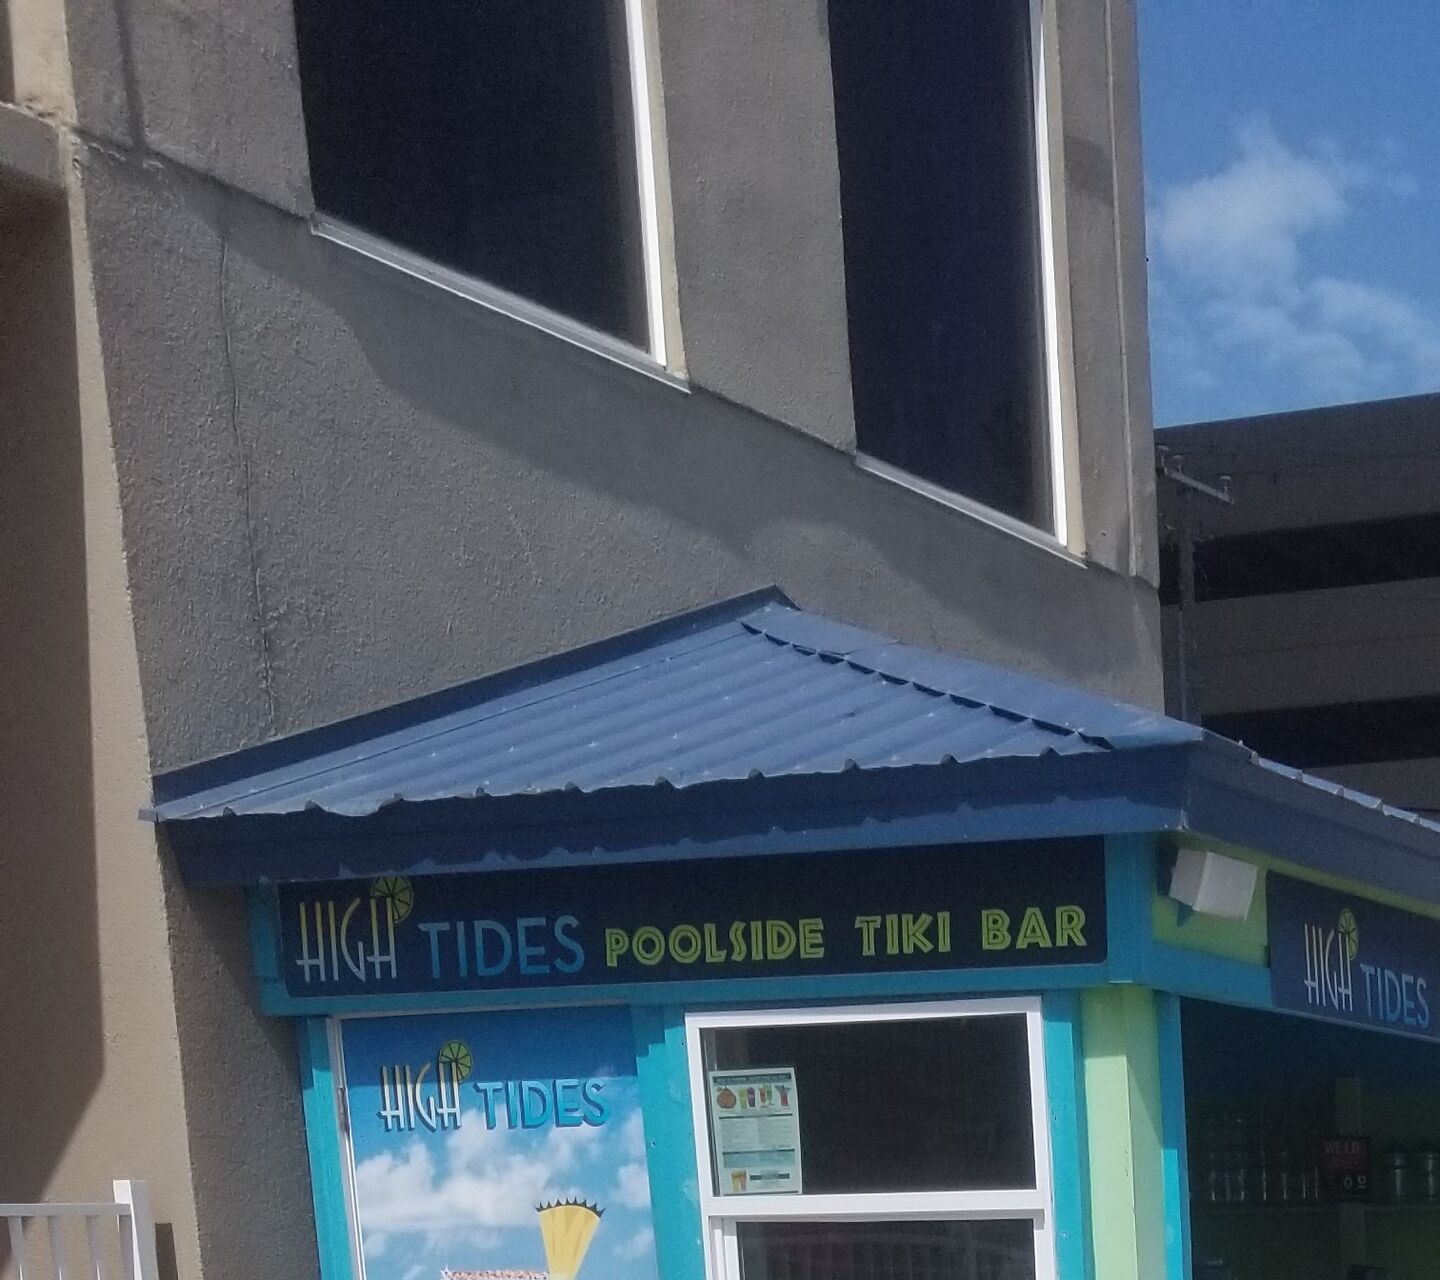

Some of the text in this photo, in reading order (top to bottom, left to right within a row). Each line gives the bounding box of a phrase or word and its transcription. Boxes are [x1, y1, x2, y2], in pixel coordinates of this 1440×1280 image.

[296, 897, 1087, 982] HIGH TIDES POOLSIDE TIKI BAR
[1304, 923, 1353, 1012] HIGH
[1360, 964, 1430, 1030] TIDES
[379, 1061, 611, 1132] HIGH TIDES
